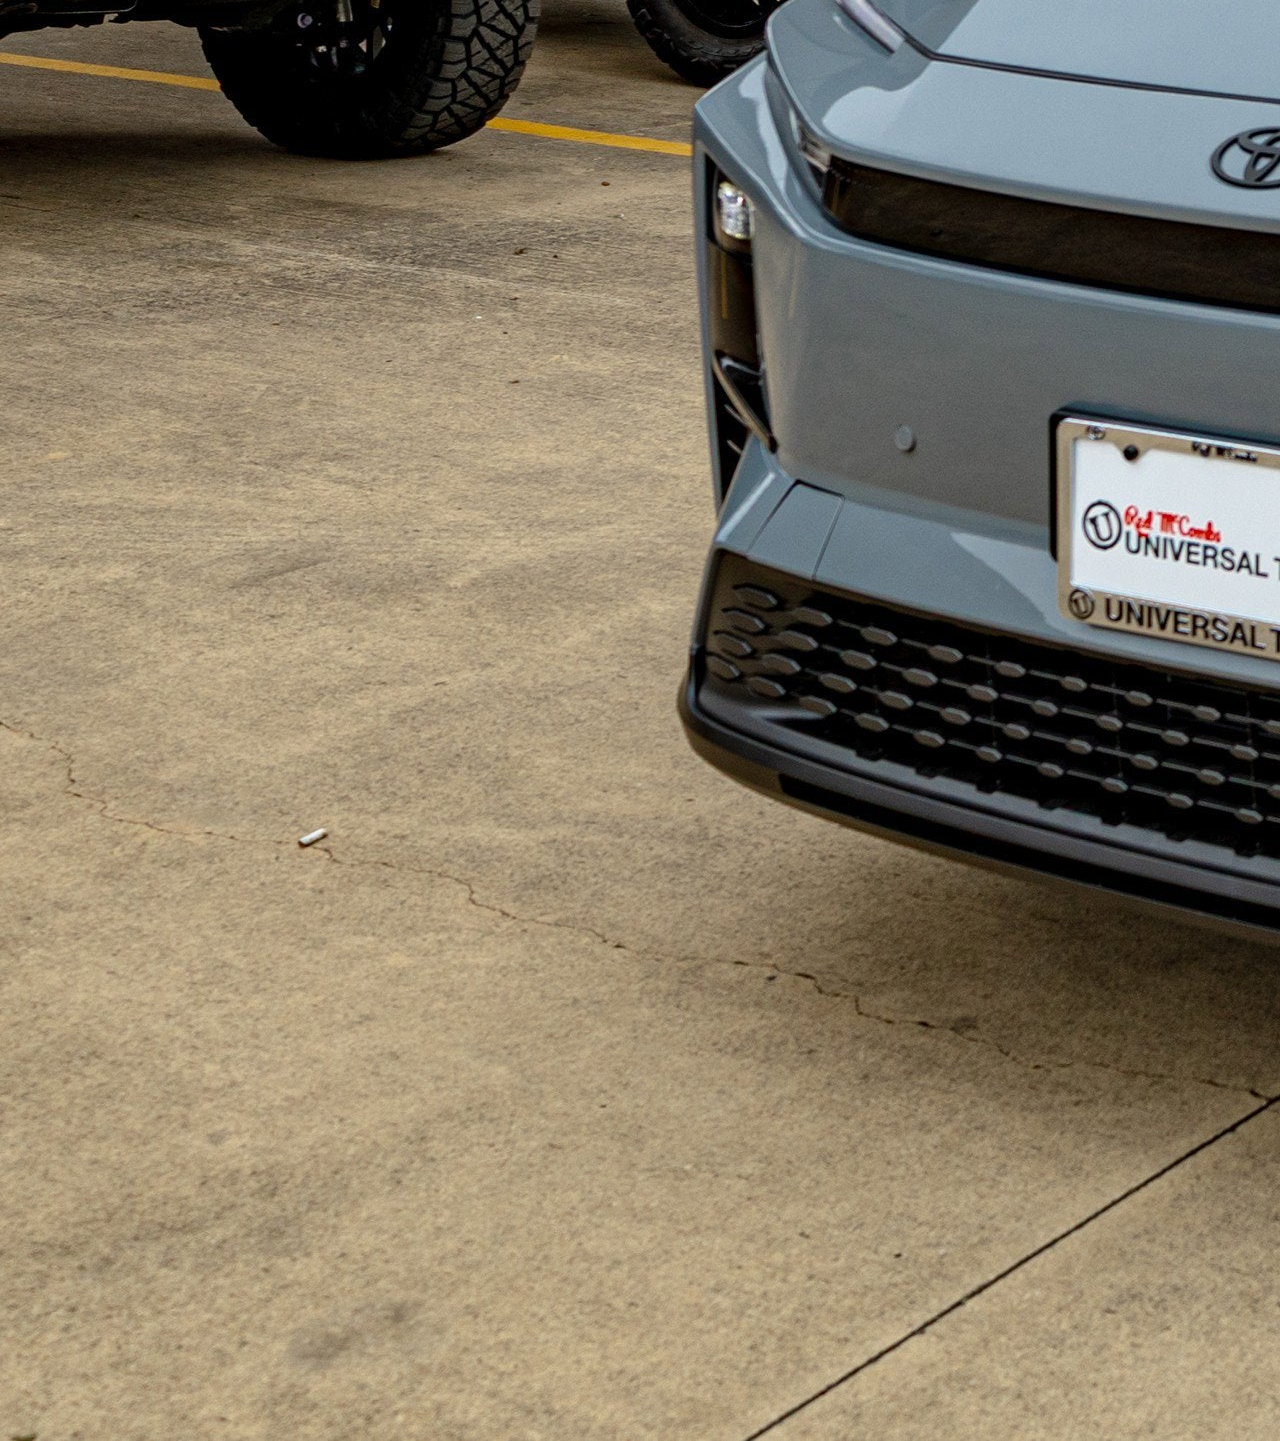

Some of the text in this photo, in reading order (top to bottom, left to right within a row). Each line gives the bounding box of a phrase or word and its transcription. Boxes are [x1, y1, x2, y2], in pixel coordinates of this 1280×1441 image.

[1124, 505, 1222, 543] Red McCombs
[1125, 530, 1269, 579] UNIVERSAL
[1104, 594, 1268, 650] UNIVERSAL
